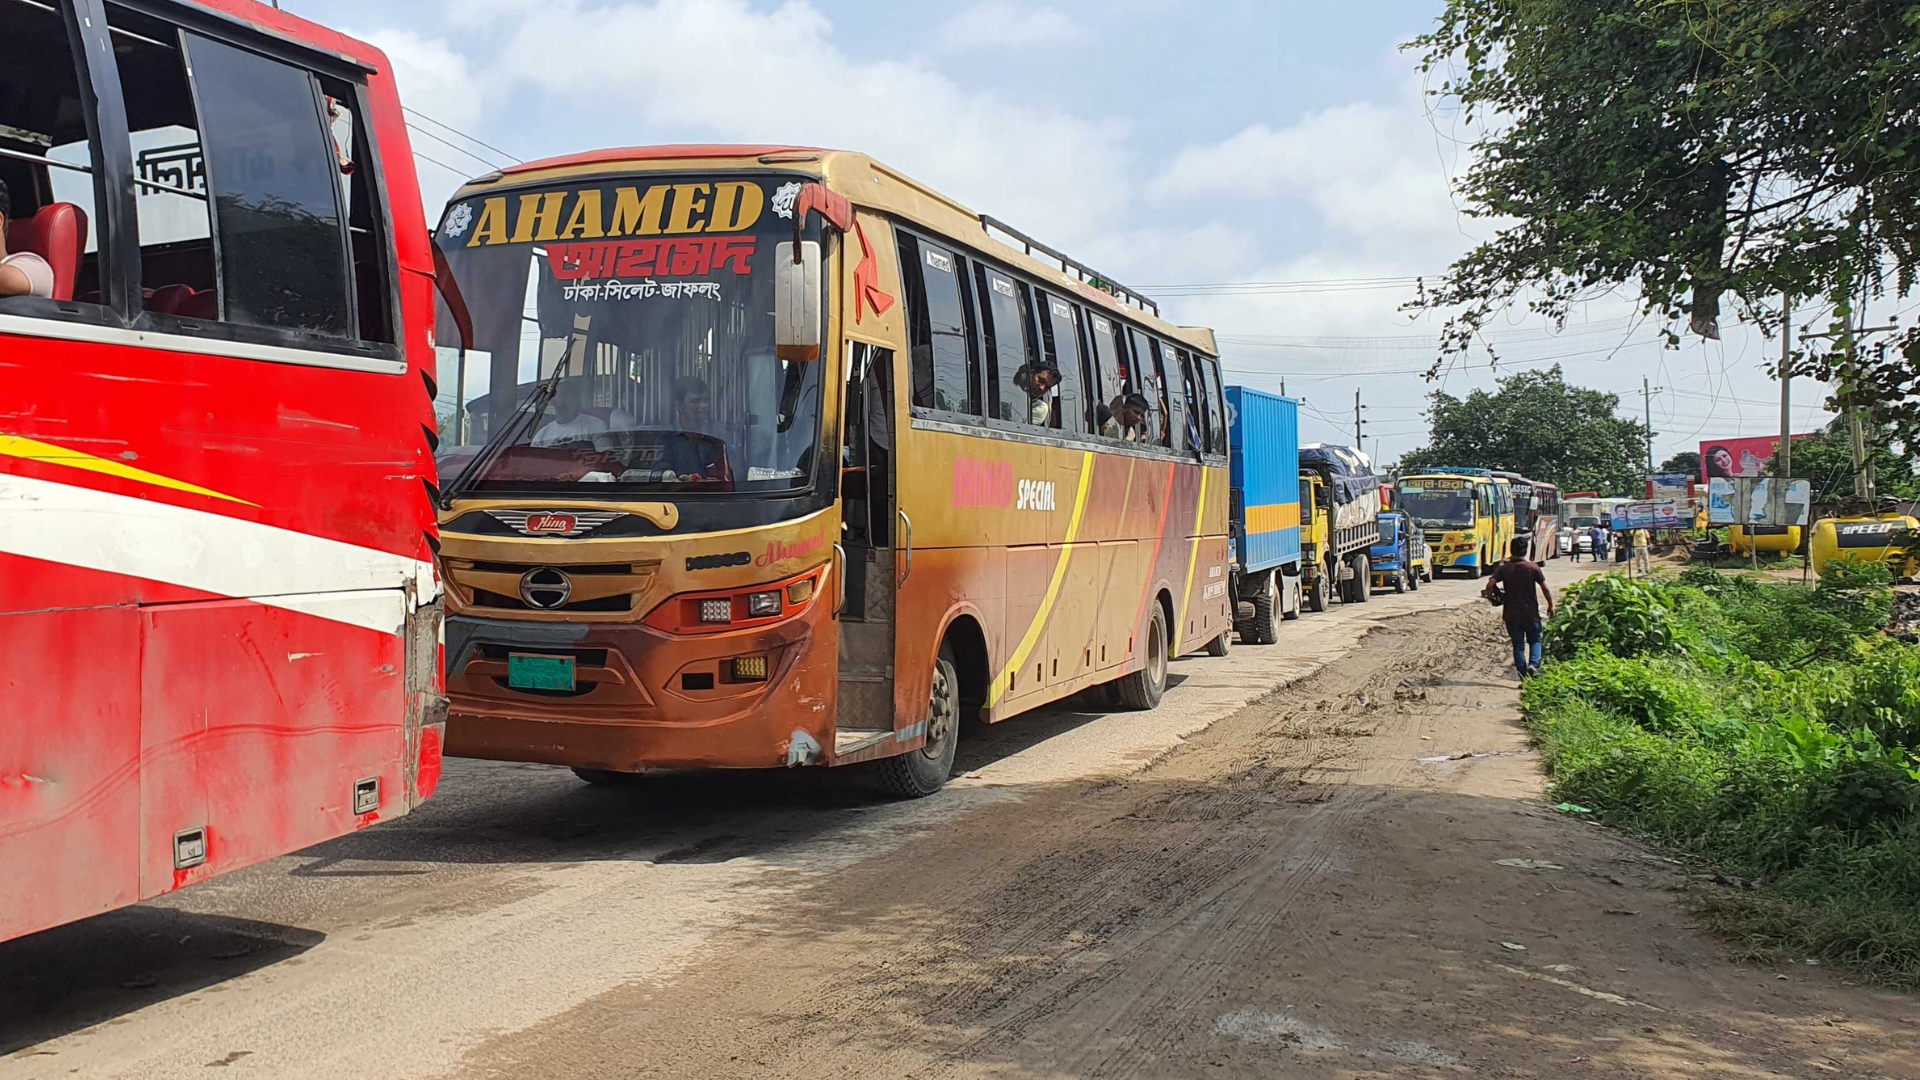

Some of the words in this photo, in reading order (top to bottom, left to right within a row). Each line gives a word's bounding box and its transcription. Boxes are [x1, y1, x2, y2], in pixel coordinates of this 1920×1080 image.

[467, 181, 765, 248] AHAMED
[1016, 479, 1056, 511] SPECIAL
[533, 515, 567, 531] Hino
[1842, 523, 1893, 535] SPEED
